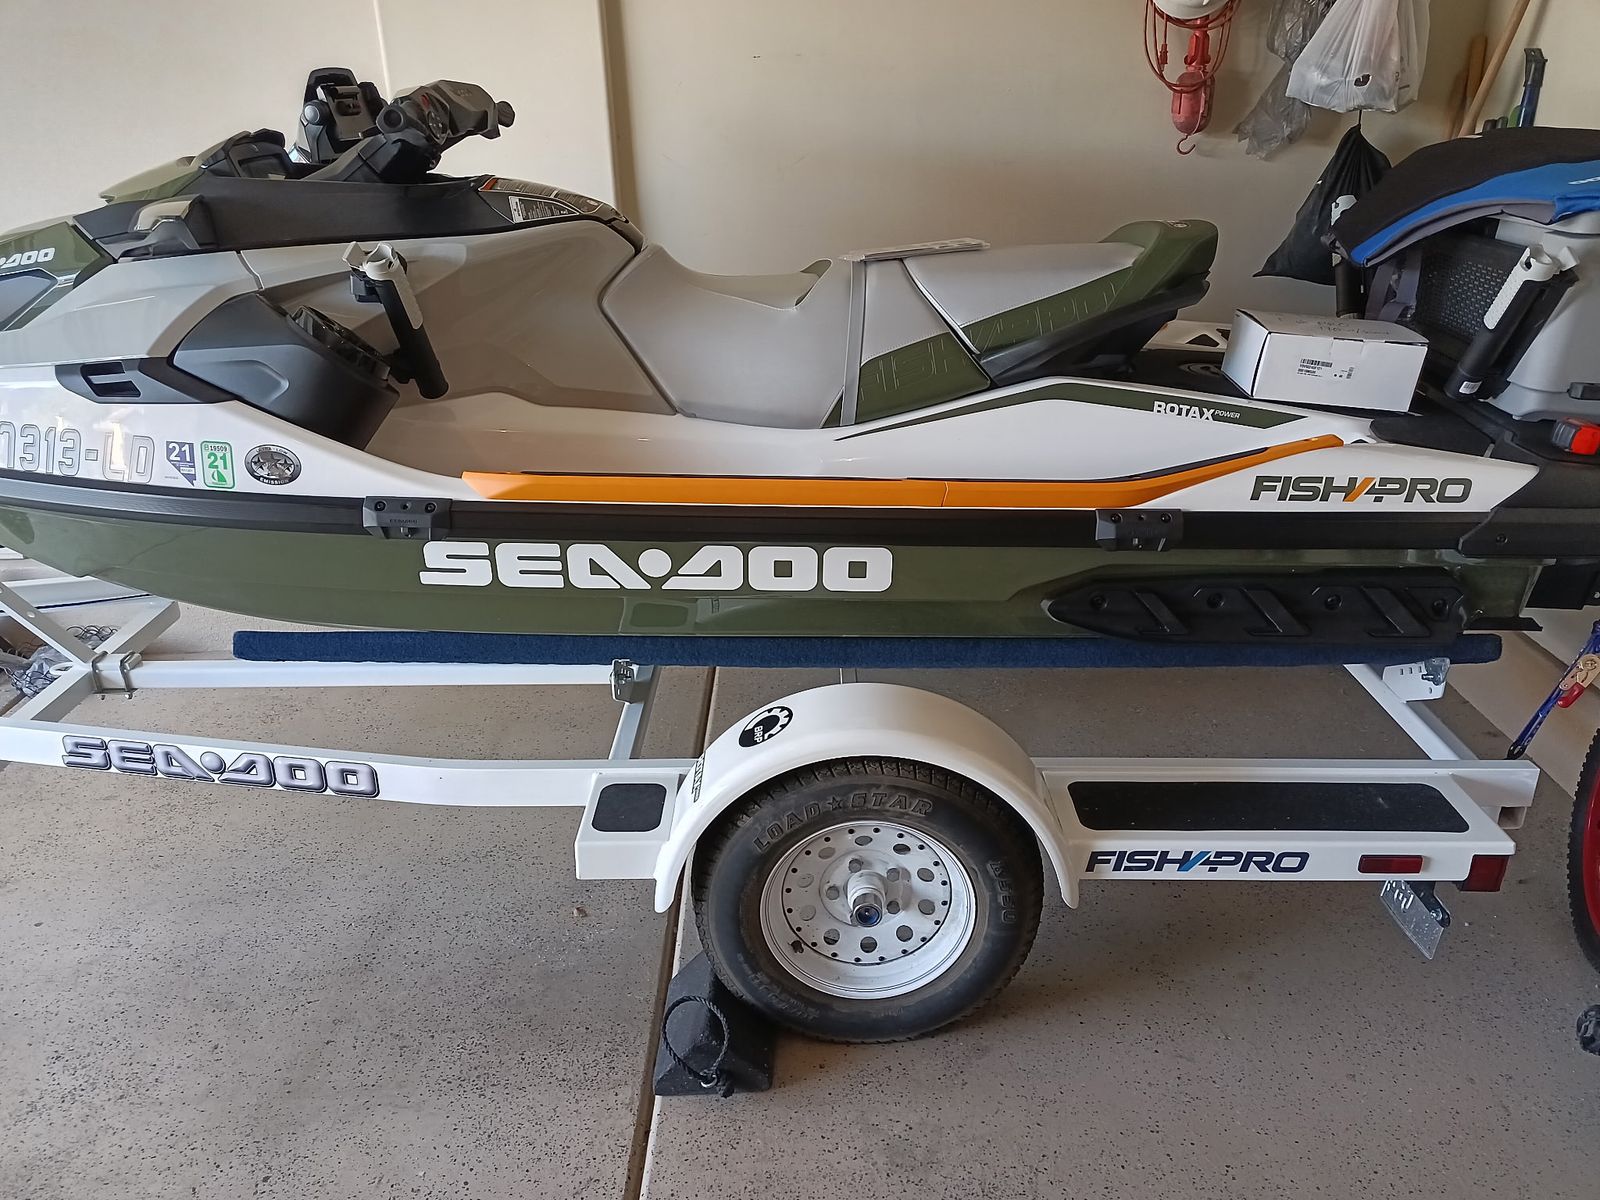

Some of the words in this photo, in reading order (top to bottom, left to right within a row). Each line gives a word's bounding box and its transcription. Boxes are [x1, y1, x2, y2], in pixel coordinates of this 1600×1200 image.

[1153, 399, 1214, 422] ROTAX
[1214, 408, 1241, 420] POWER
[168, 442, 191, 462] 21
[207, 452, 228, 470] 21
[753, 725, 764, 743] BRP
[753, 802, 821, 852] LOAD
[849, 791, 934, 817] STAR
